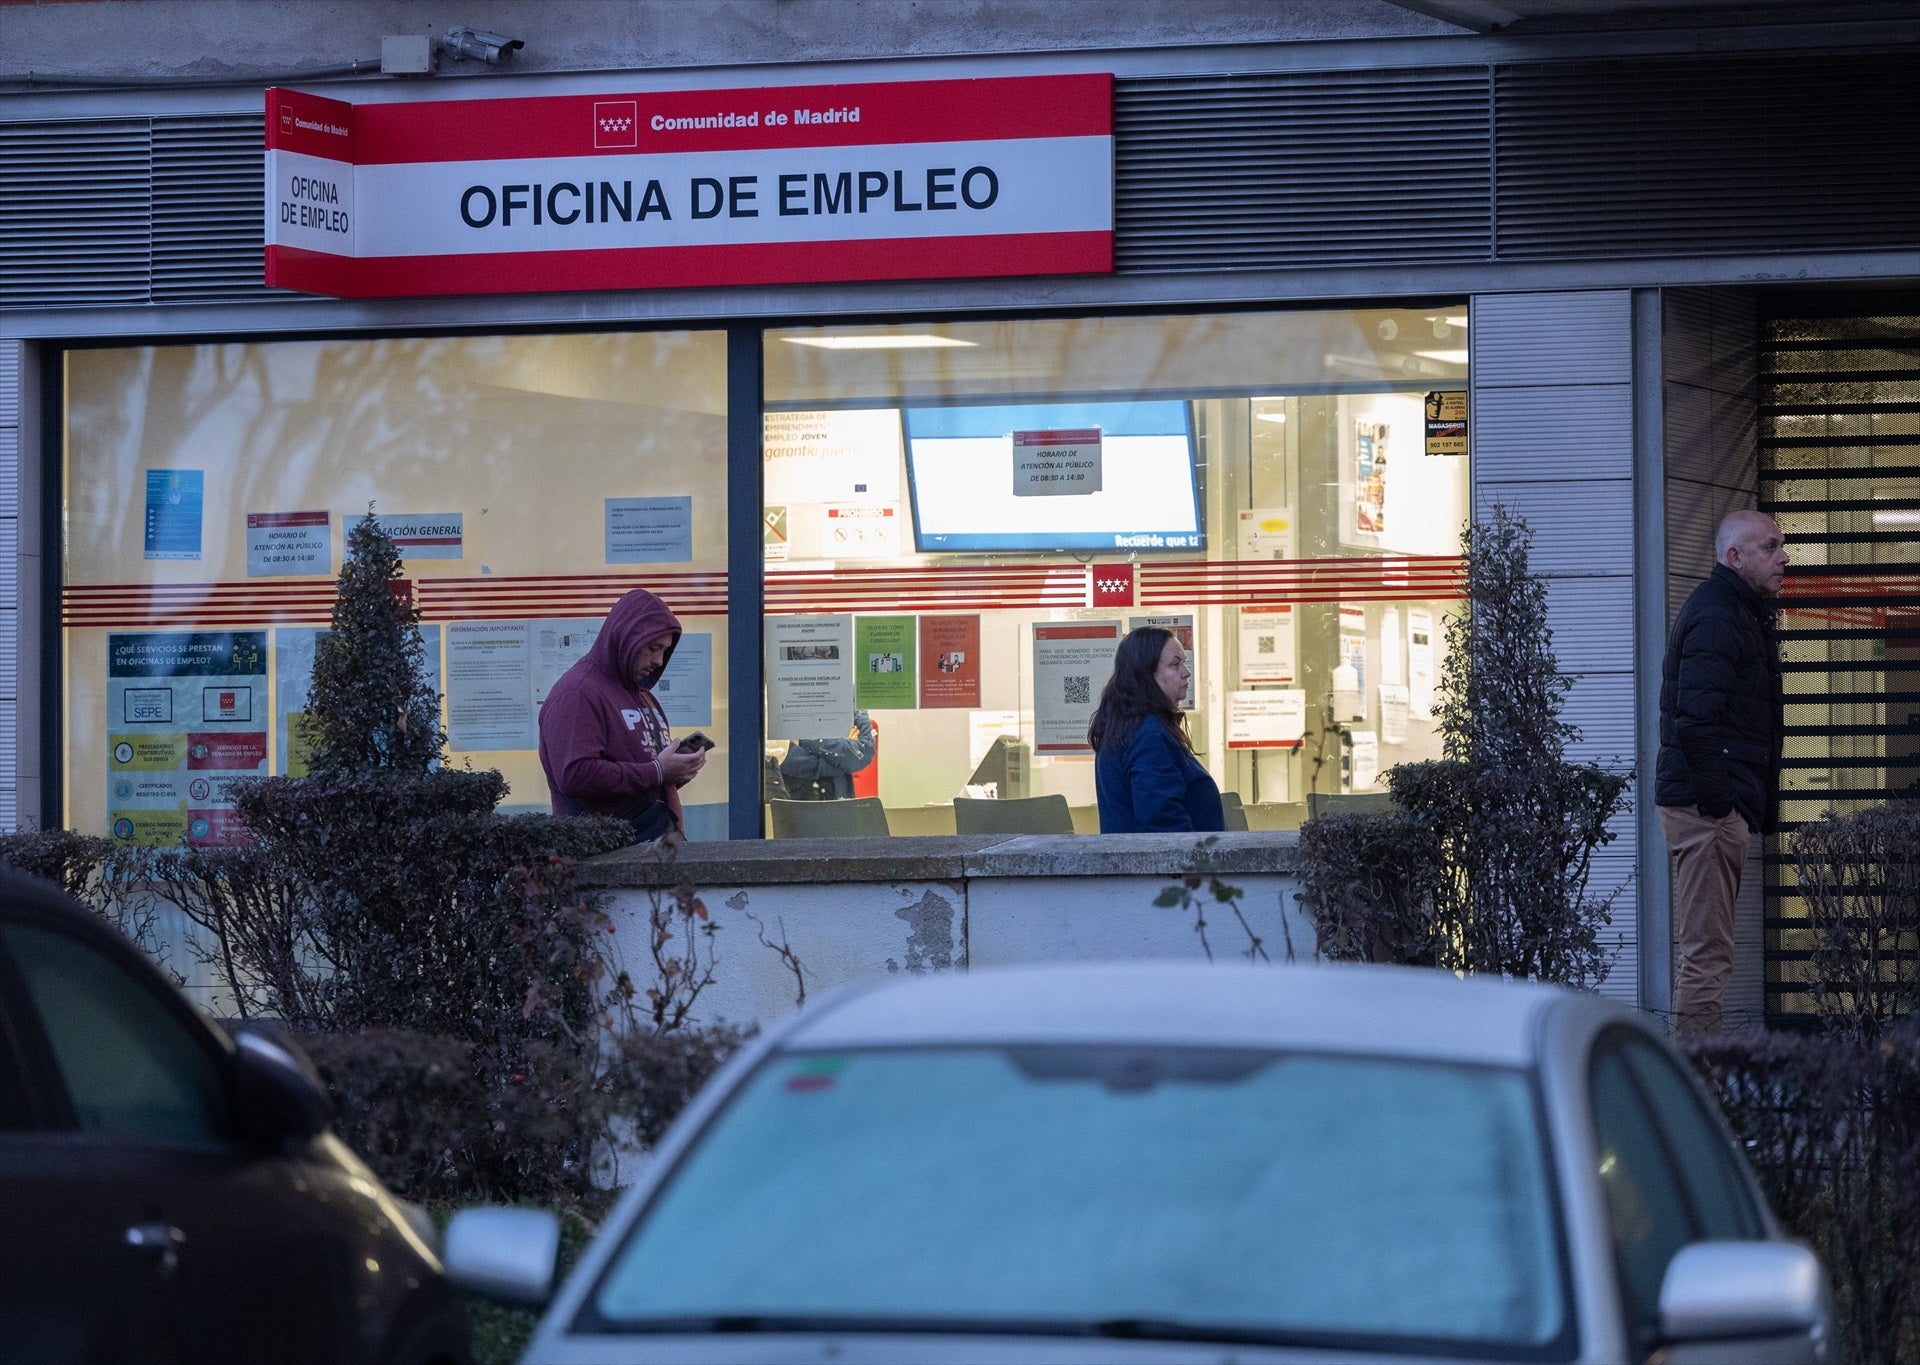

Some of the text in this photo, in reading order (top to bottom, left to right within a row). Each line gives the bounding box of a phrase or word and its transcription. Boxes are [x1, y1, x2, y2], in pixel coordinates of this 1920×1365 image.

[651, 106, 861, 131] Comunidad de Madrid
[295, 117, 349, 137] Comunidad de Madrid
[291, 175, 339, 205] OFICINA
[460, 165, 999, 229] OFICINA DE EMPLEO
[281, 201, 349, 234] DE EMPLEO
[800, 433, 827, 441] JOVEN
[1036, 450, 1067, 458] HORARIO
[1020, 462, 1055, 470] ATENCIÓN
[1065, 460, 1094, 468] PÚBLICO
[1066, 473, 1085, 481] 14:30
[268, 532, 297, 540] HORARIO
[419, 525, 462, 536] GENERAL
[254, 542, 286, 551] ATENCIÓN
[295, 541, 323, 550] PÚBLICO
[1115, 534, 1164, 547] Recuerde
[1165, 536, 1187, 548] que
[272, 555, 290, 563] 08:30
[297, 554, 315, 562] 14:30
[115, 644, 223, 656] ¿QUÉ SERVICIOS SE PRESTAN
[116, 656, 212, 666] EN OFICINAS DE EMPLEO?
[134, 707, 162, 718] SEPE
